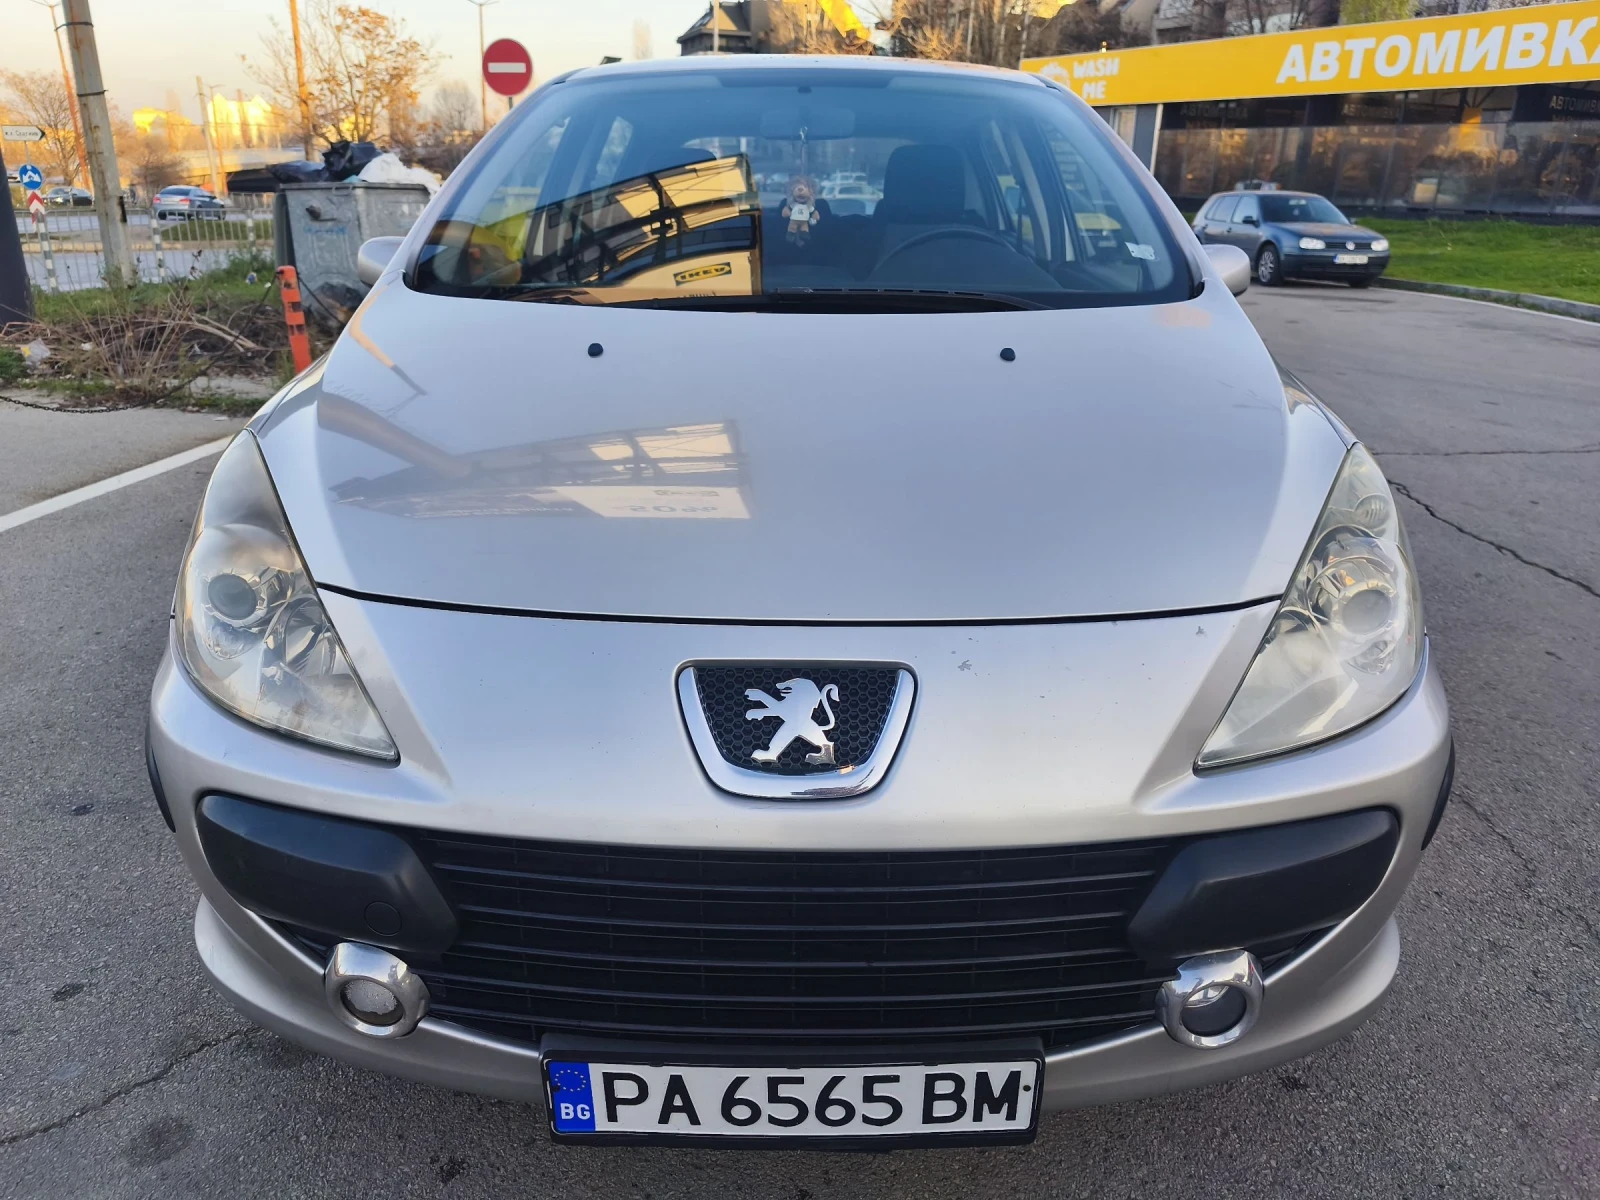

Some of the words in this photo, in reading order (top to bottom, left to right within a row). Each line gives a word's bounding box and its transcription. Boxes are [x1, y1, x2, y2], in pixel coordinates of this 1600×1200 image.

[1073, 57, 1120, 79] WASH
[1082, 81, 1107, 100] ME
[602, 1071, 701, 1125] PA
[720, 1074, 903, 1127] 6565
[921, 1070, 1022, 1125] BM
[560, 1102, 591, 1120] BG
